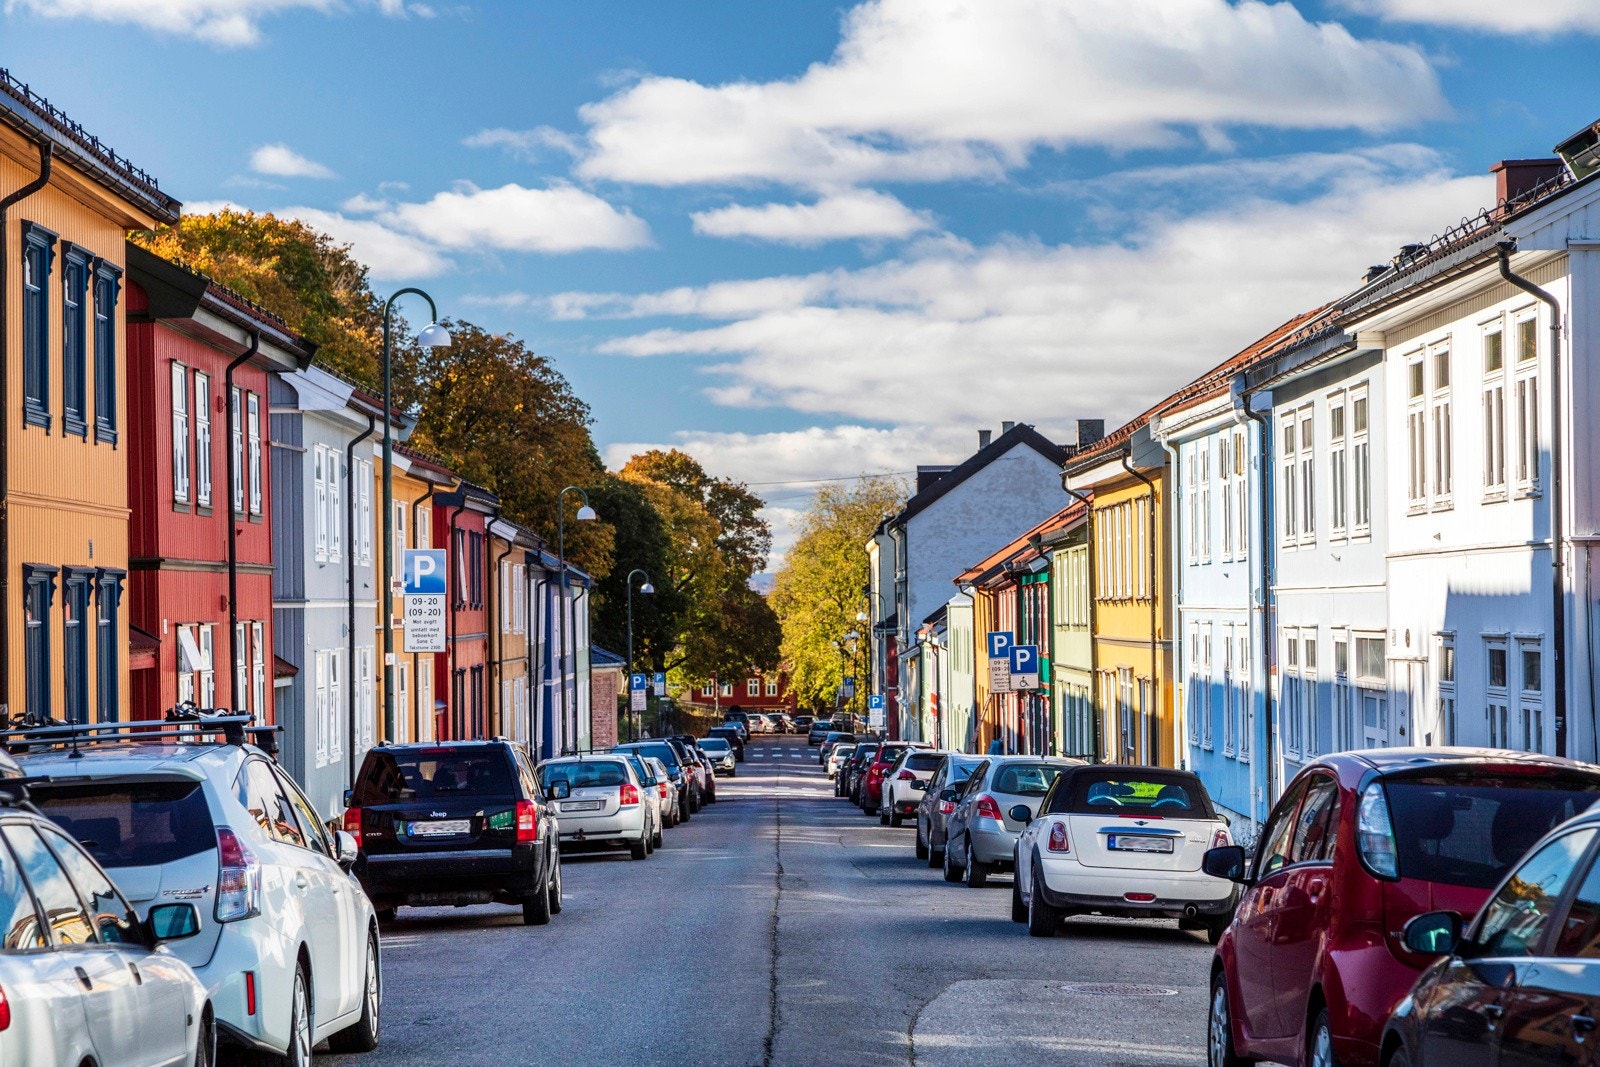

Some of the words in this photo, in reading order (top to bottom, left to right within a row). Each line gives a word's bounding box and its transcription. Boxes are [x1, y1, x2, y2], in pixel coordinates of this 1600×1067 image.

[414, 555, 436, 588] P
[412, 597, 438, 606] 09-20
[408, 608, 442, 617] (09-20)
[993, 635, 1008, 655] P
[1015, 649, 1031, 671] P
[633, 676, 642, 689] P
[656, 673, 662, 682] P
[872, 697, 880, 708] P
